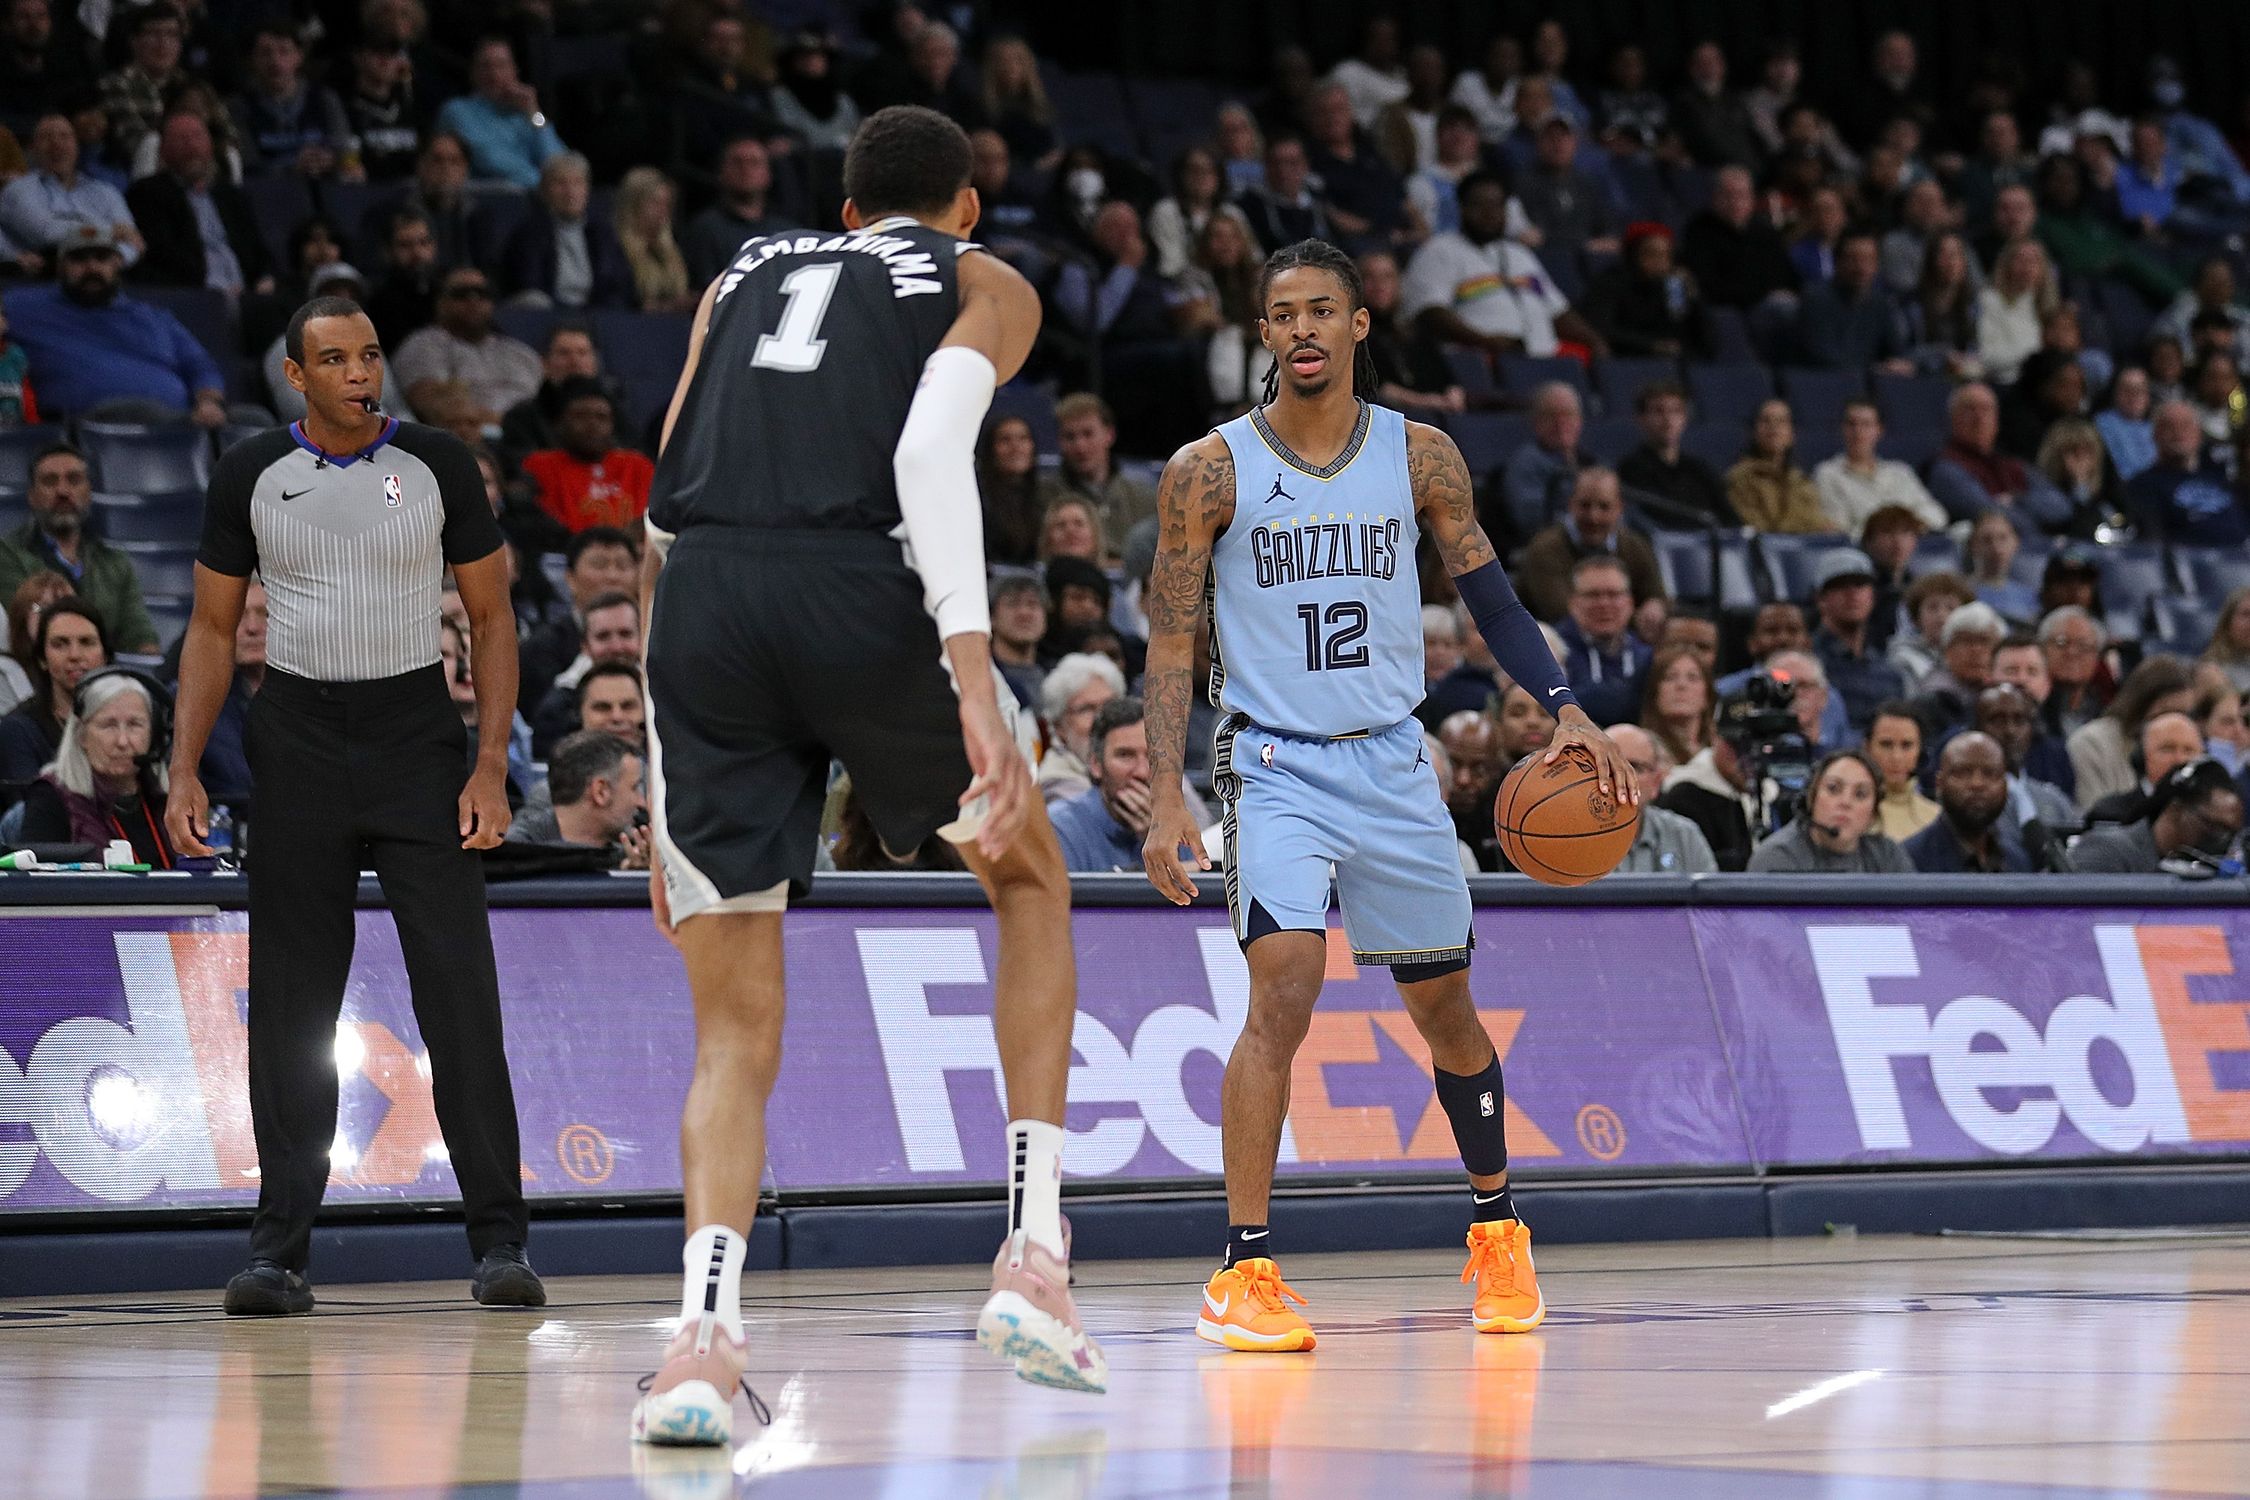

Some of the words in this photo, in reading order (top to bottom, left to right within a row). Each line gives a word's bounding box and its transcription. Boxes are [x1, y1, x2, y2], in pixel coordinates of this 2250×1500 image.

[750, 261, 844, 373] 1
[1250, 518, 1401, 588] GRIZZLIES
[1271, 512, 1386, 530] MEMPHIS
[1297, 600, 1370, 671] 12
